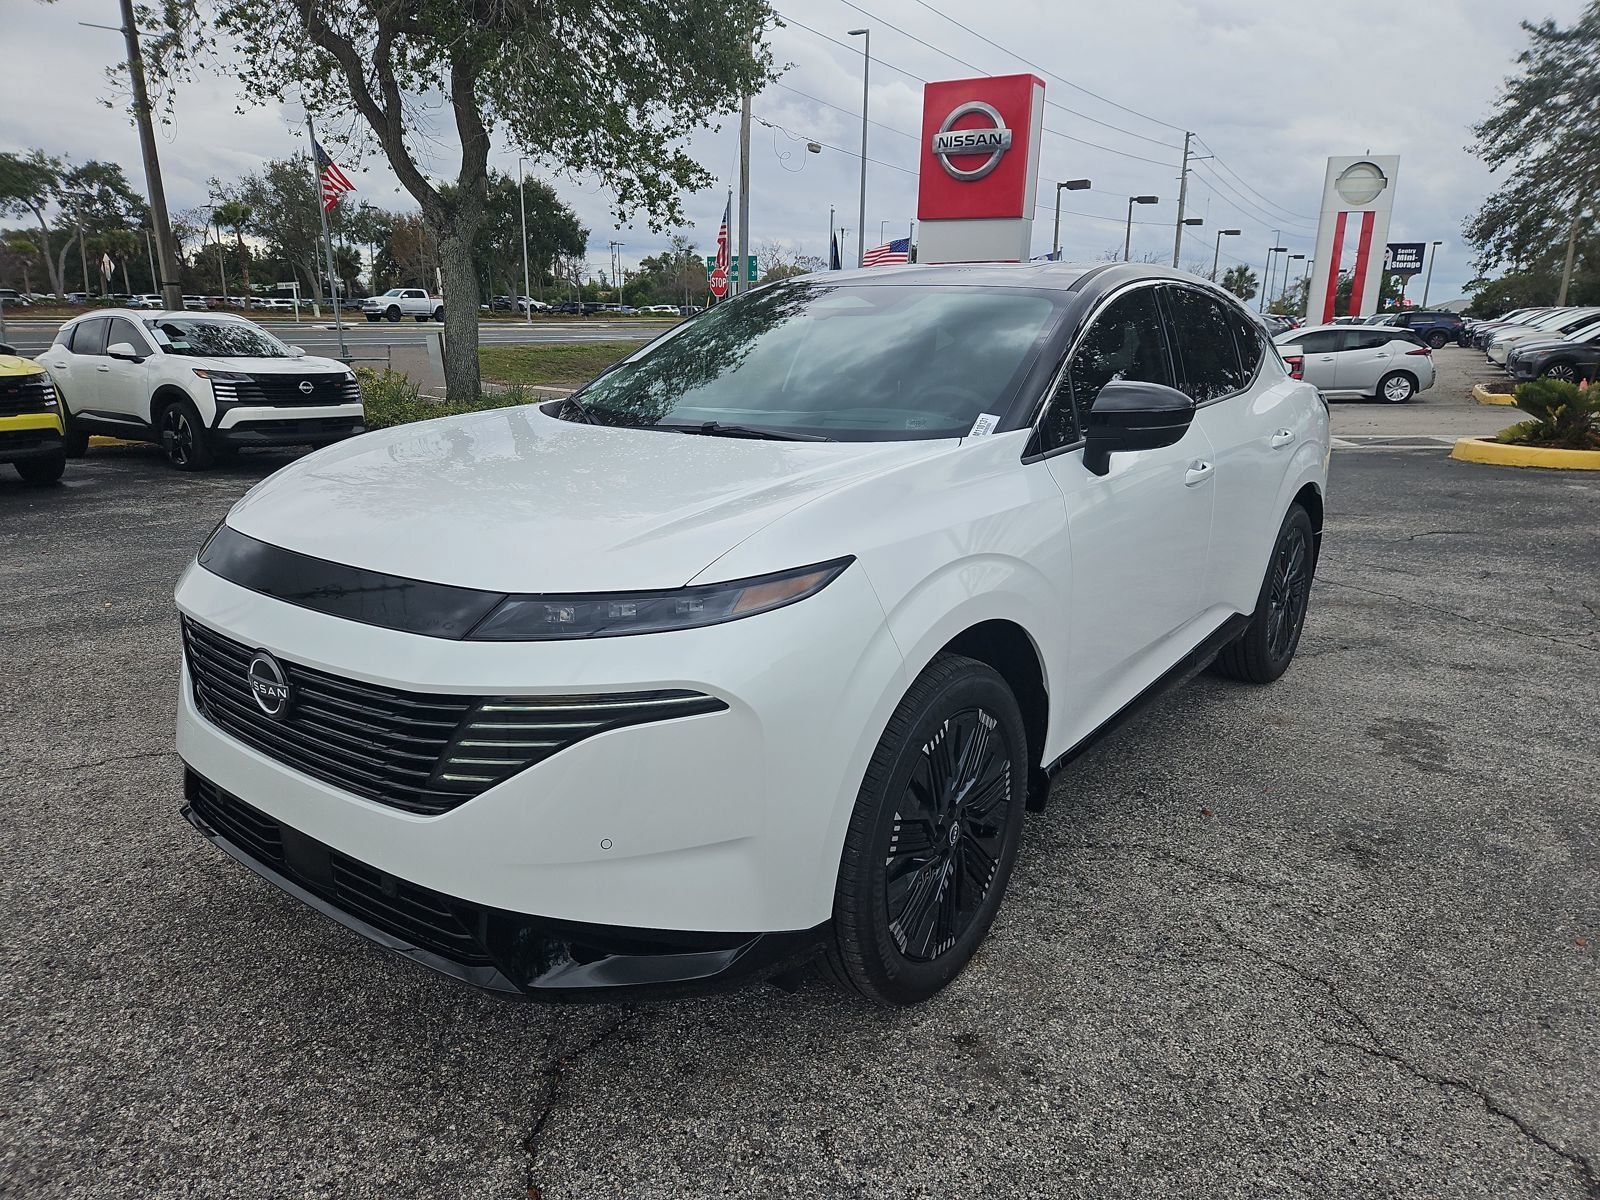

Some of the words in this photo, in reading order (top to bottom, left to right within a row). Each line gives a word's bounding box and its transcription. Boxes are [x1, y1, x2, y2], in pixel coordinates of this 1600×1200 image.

[938, 133, 1002, 149] NISSAN
[1391, 261, 1421, 269] Storage
[711, 277, 727, 288] STOP
